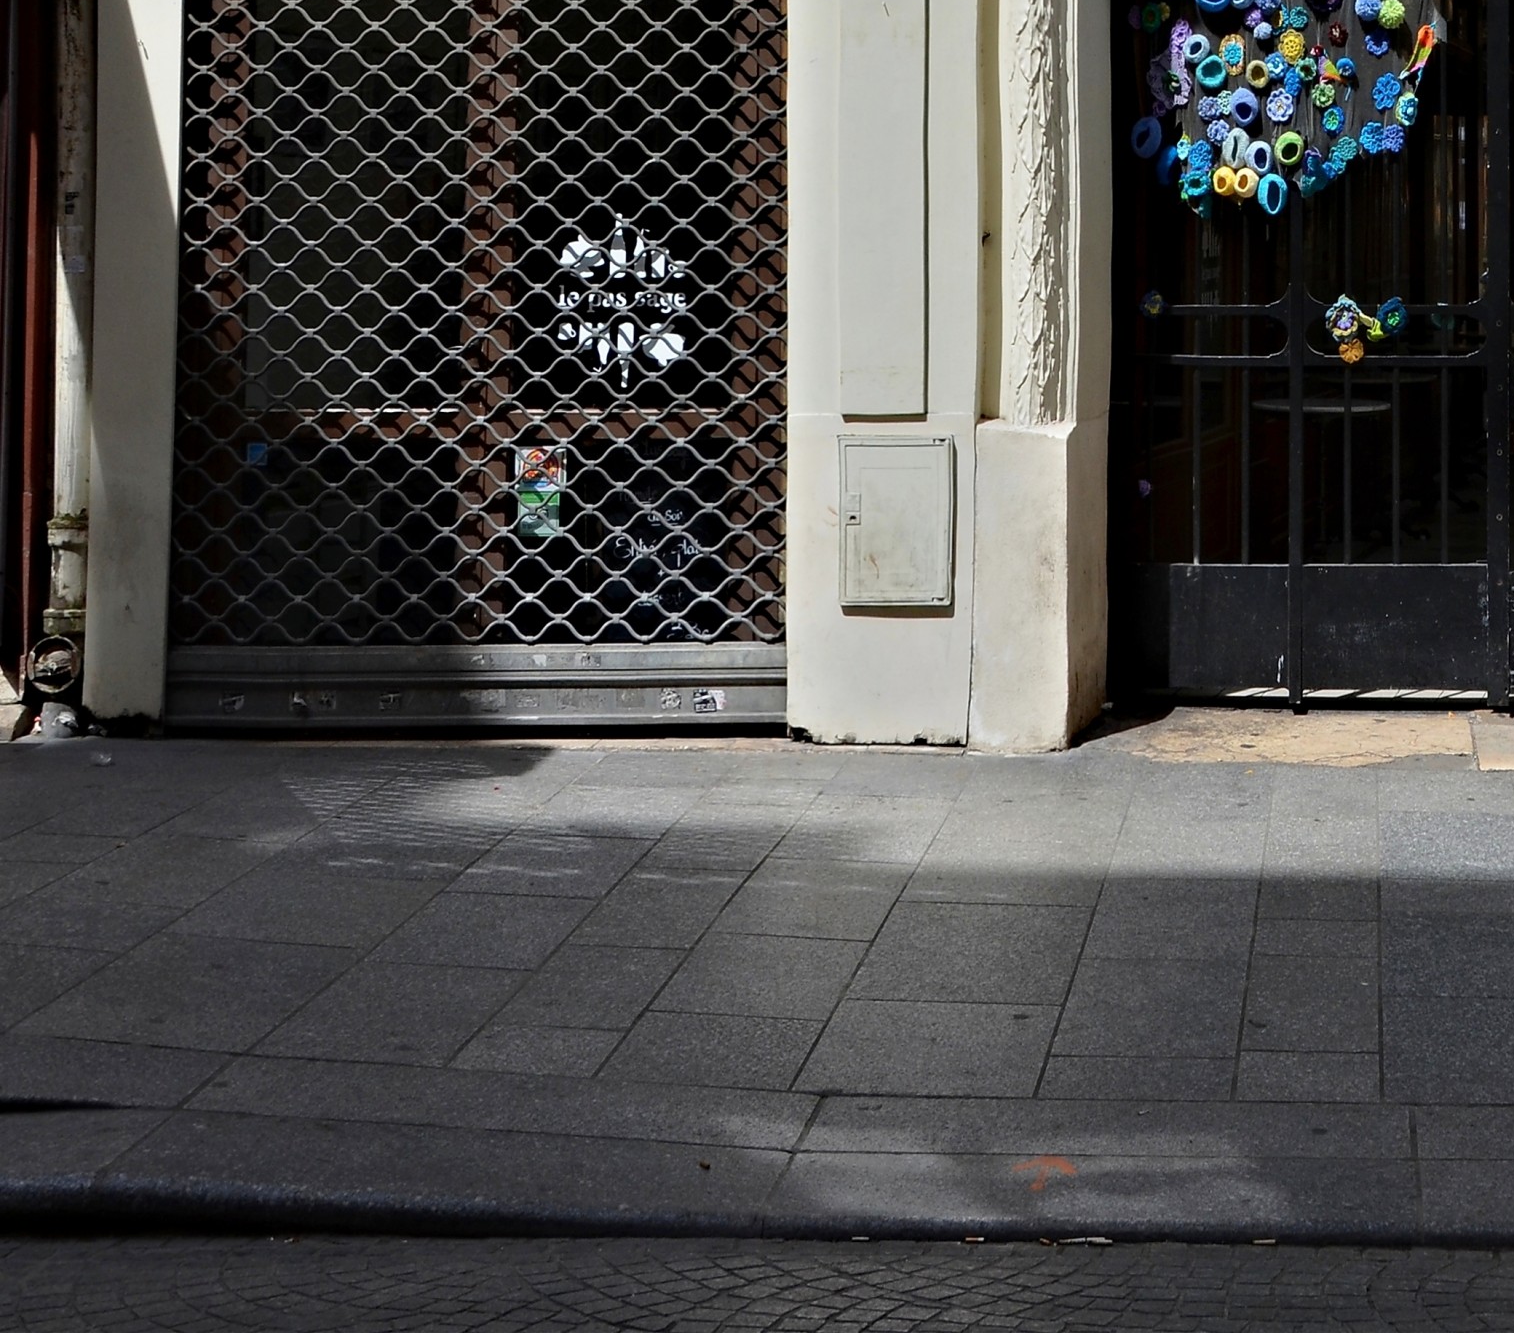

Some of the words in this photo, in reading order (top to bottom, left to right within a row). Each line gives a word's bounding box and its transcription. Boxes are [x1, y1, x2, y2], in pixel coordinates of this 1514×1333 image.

[558, 285, 580, 308] le
[587, 292, 628, 313] pas
[634, 291, 688, 314] sage
